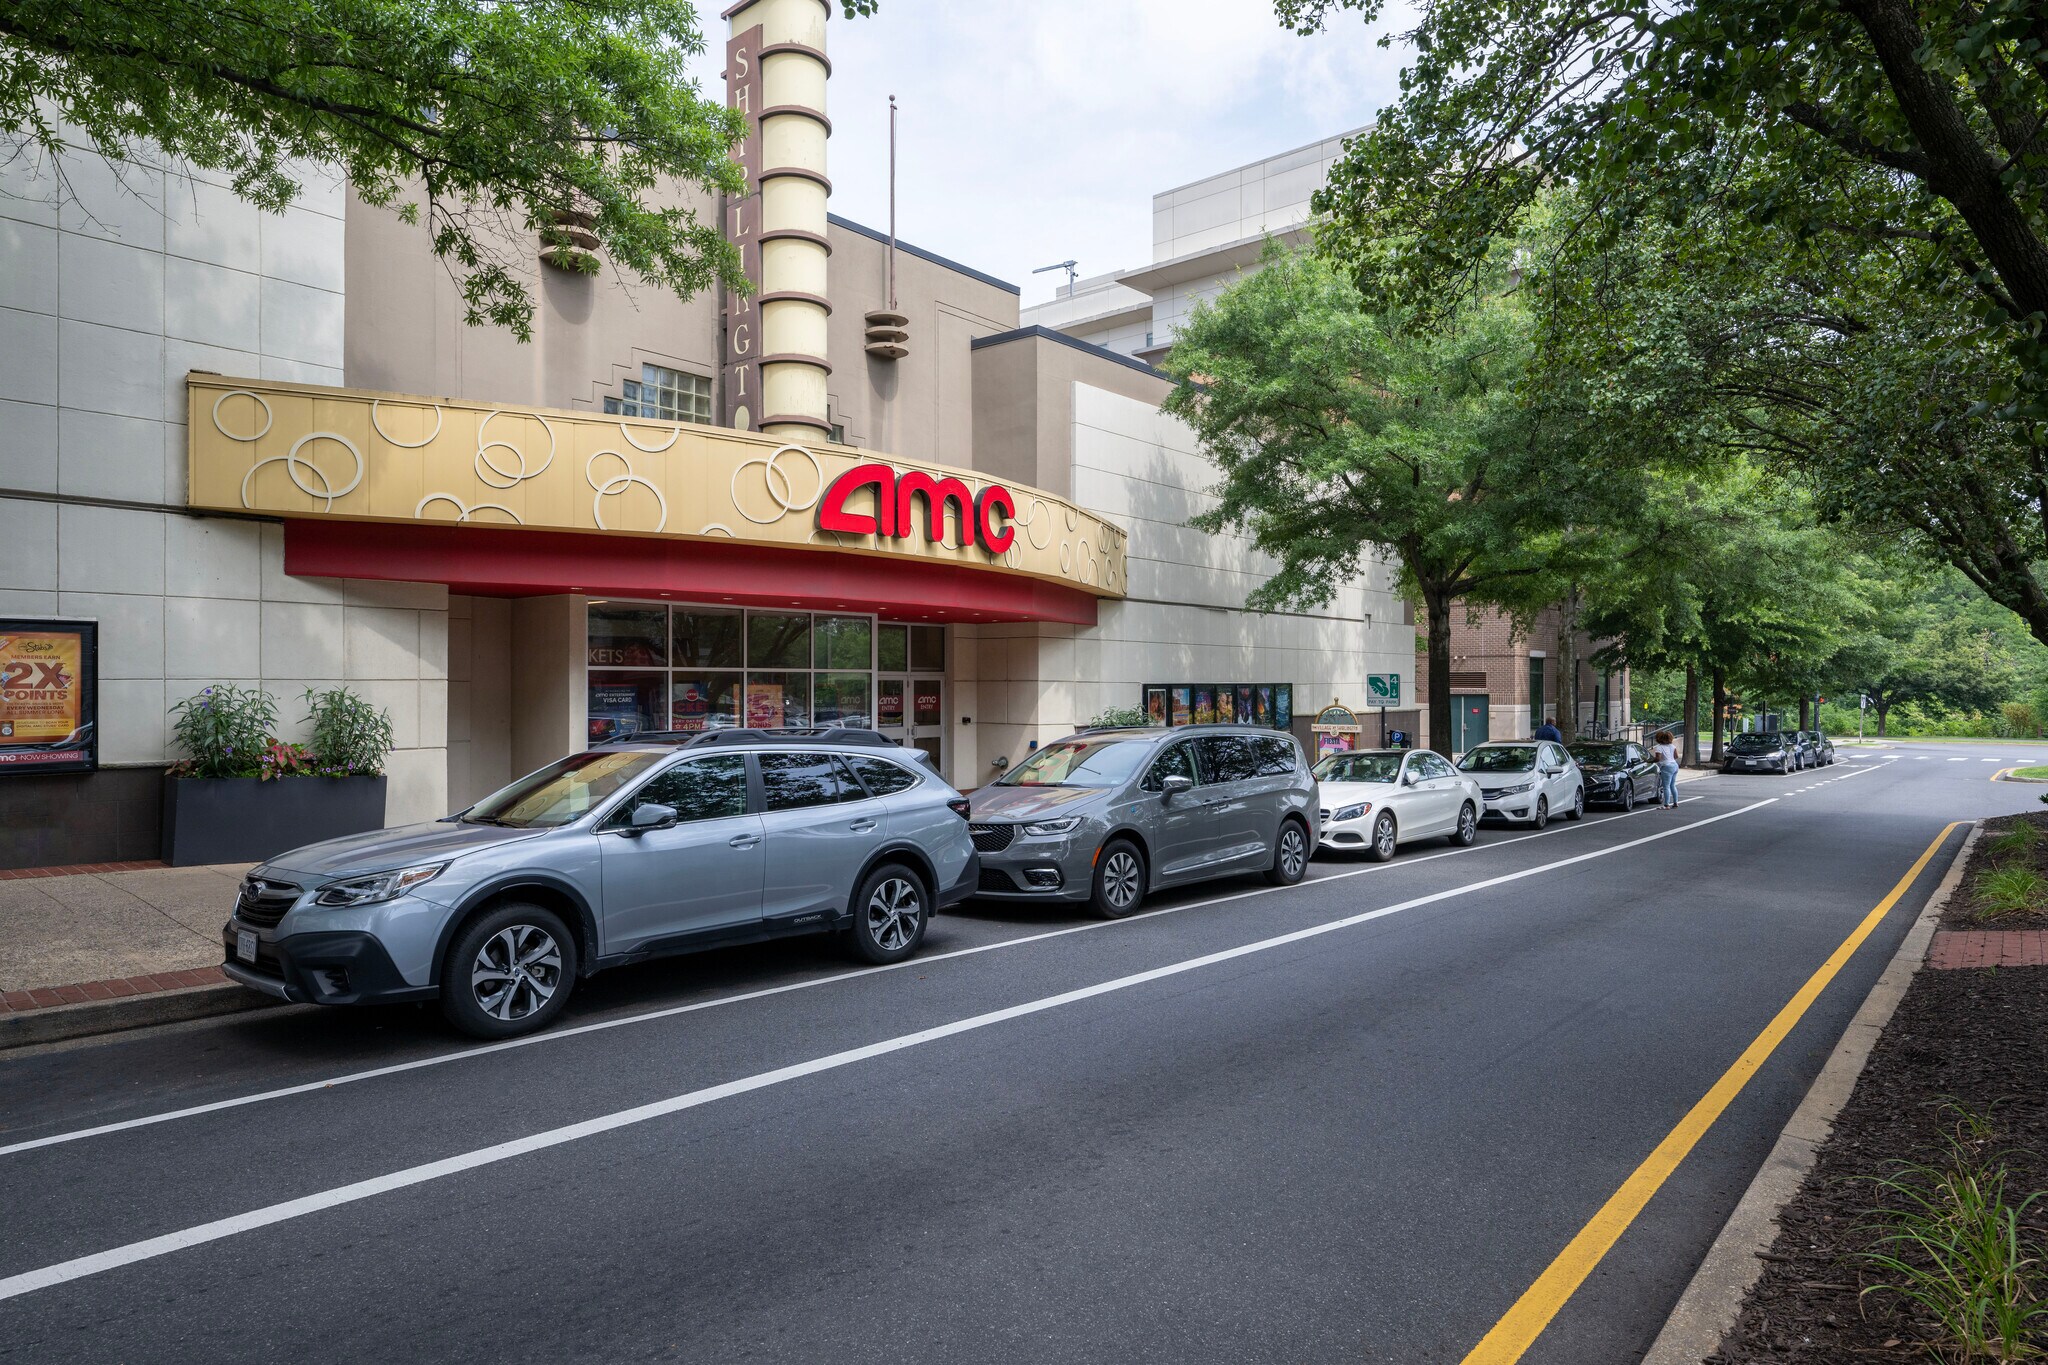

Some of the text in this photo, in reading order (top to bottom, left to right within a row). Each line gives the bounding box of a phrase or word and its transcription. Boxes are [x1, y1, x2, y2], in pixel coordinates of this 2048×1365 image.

[5, 661, 66, 690] 2X
[1390, 676, 1398, 684] 4
[4, 690, 68, 700] POINTS
[683, 723, 701, 731] 4PM
[793, 914, 822, 923] OUTBACK
